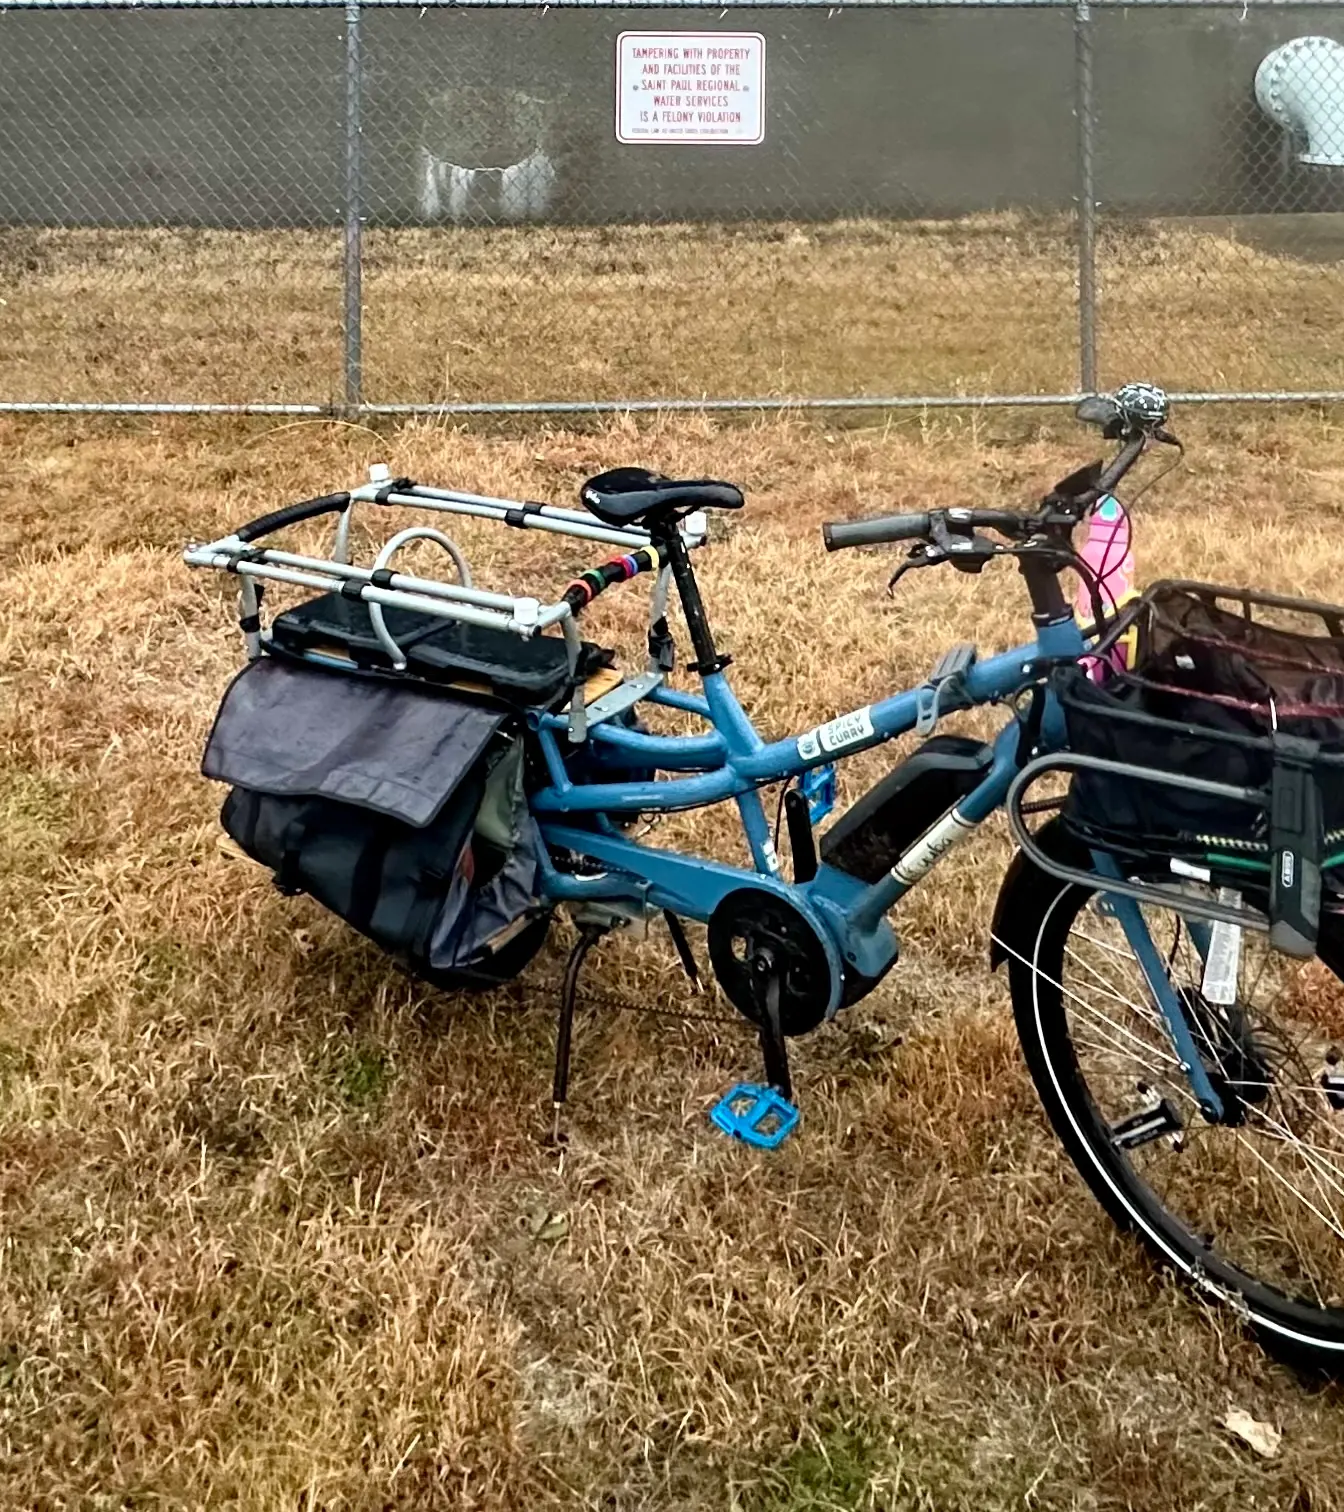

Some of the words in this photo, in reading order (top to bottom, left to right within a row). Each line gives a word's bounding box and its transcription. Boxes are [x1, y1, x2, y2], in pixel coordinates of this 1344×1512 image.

[632, 48, 679, 59] TAMPERING
[683, 48, 703, 59] WITH
[707, 48, 750, 59] PROPERTY
[642, 64, 659, 75] AND
[664, 64, 706, 75] FACILITIES
[711, 64, 722, 75] OF
[725, 64, 740, 75] THE
[642, 80, 666, 91] SAINT
[671, 80, 692, 91] PAUL
[696, 80, 740, 91] REGIONAL
[653, 95, 681, 106] WATER
[686, 96, 728, 107] SERVICES
[640, 111, 648, 122] IS
[652, 111, 659, 122] A
[662, 111, 694, 122] FELONY
[698, 112, 741, 122] VIOLATION
[828, 713, 861, 734] SPICY
[829, 725, 864, 746] CURRY
